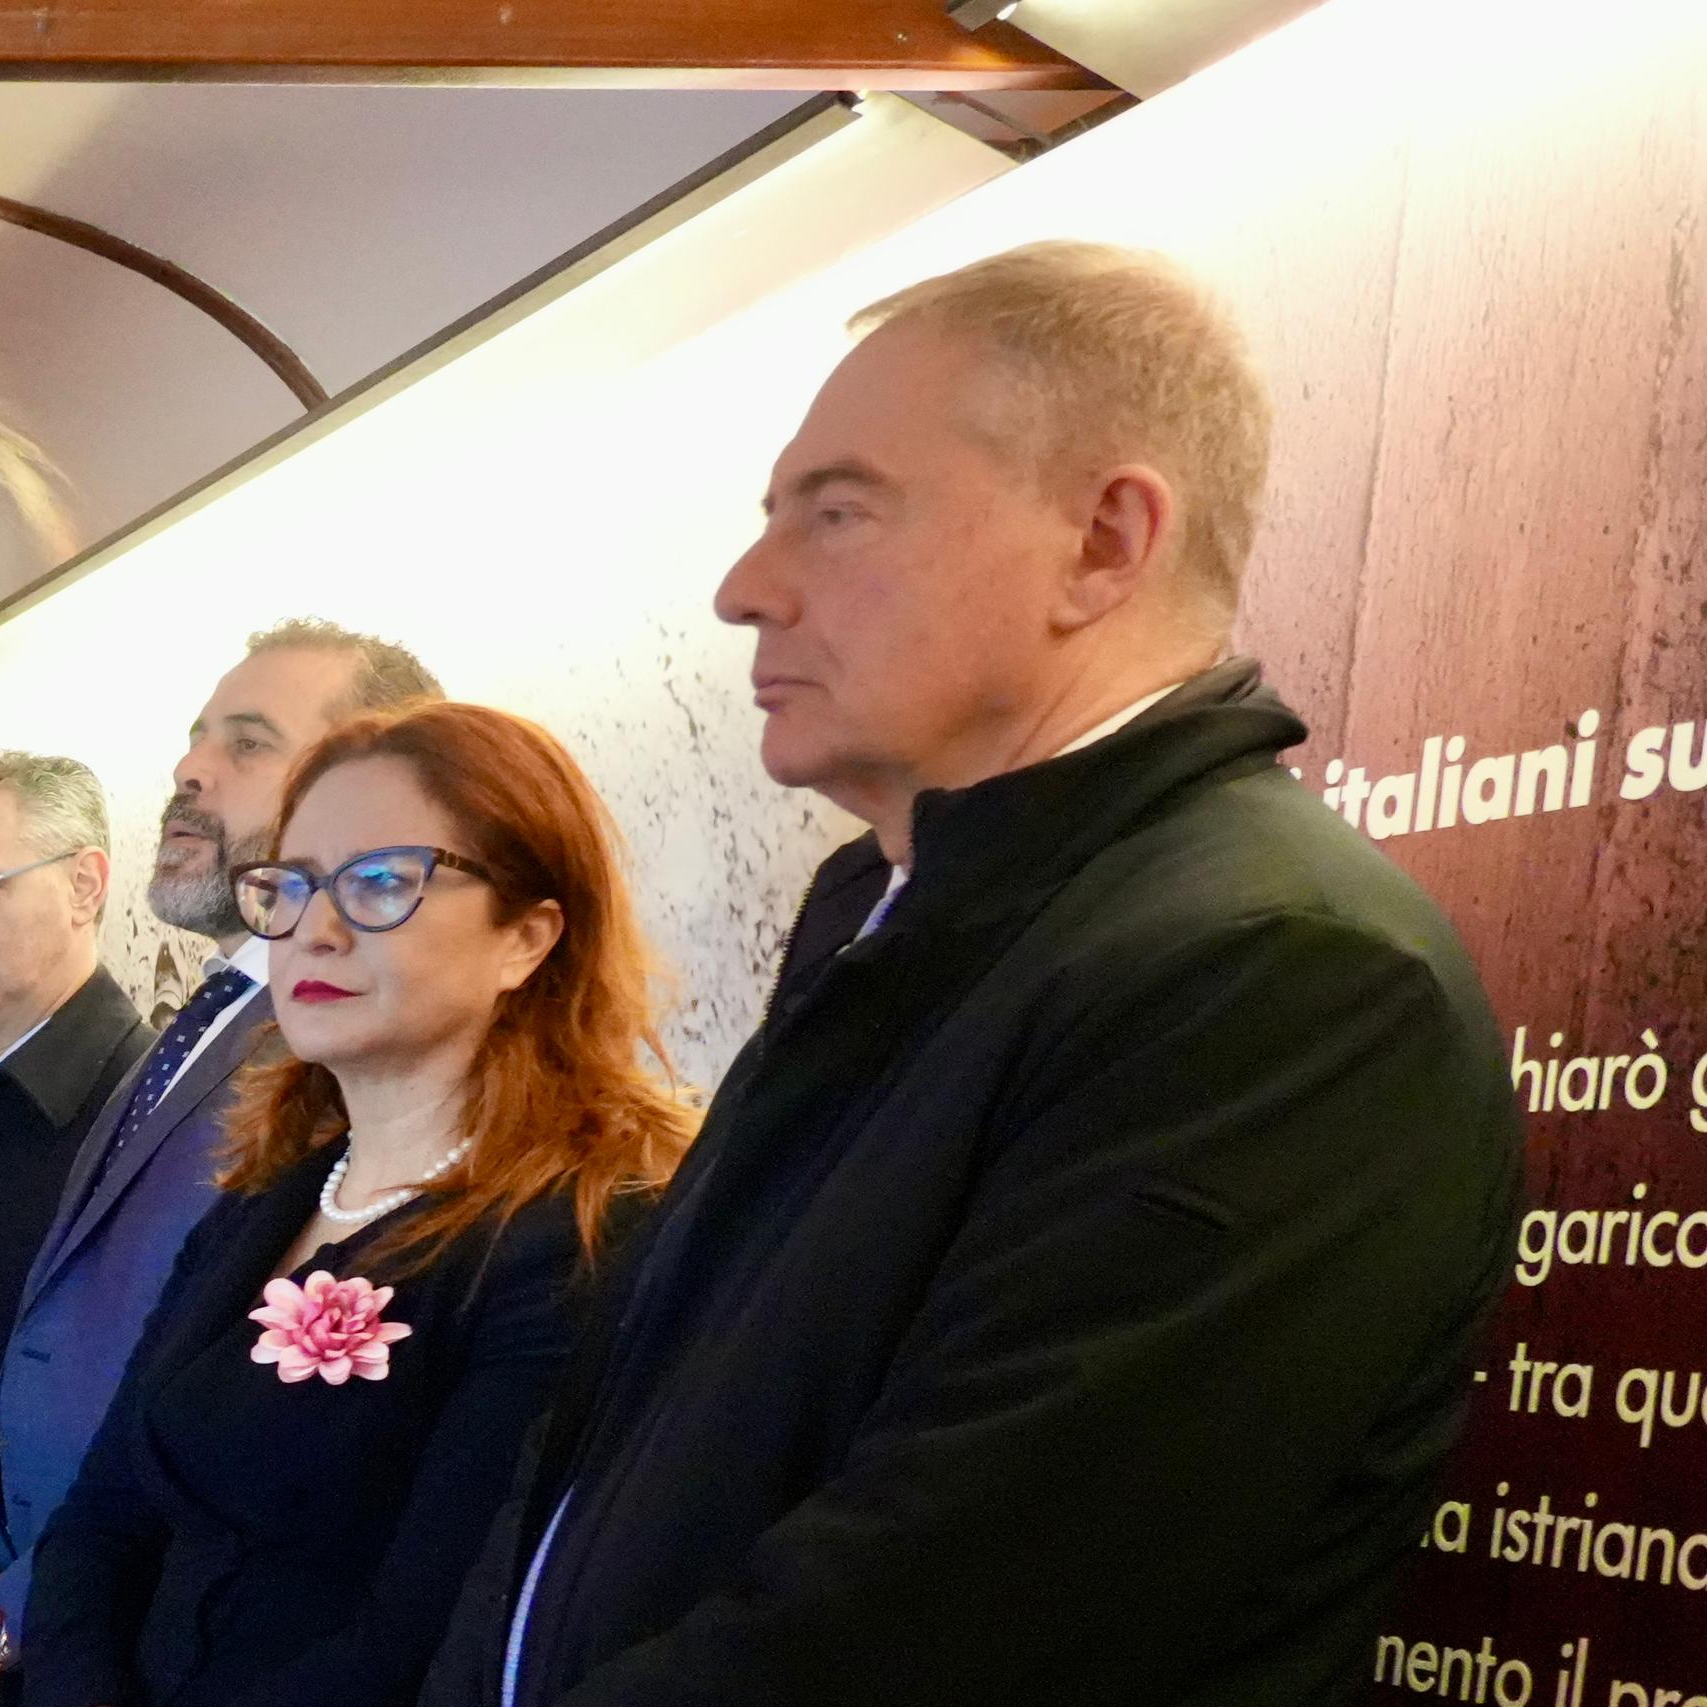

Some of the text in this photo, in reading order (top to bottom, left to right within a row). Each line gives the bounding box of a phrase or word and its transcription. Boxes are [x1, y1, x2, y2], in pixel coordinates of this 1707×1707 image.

[1323, 709, 1600, 841] italiani
[1511, 1026, 1667, 1113] hiarò
[1515, 1182, 1707, 1287] garico
[1508, 1342, 1594, 1418] tra
[1615, 1367, 1707, 1449] qu
